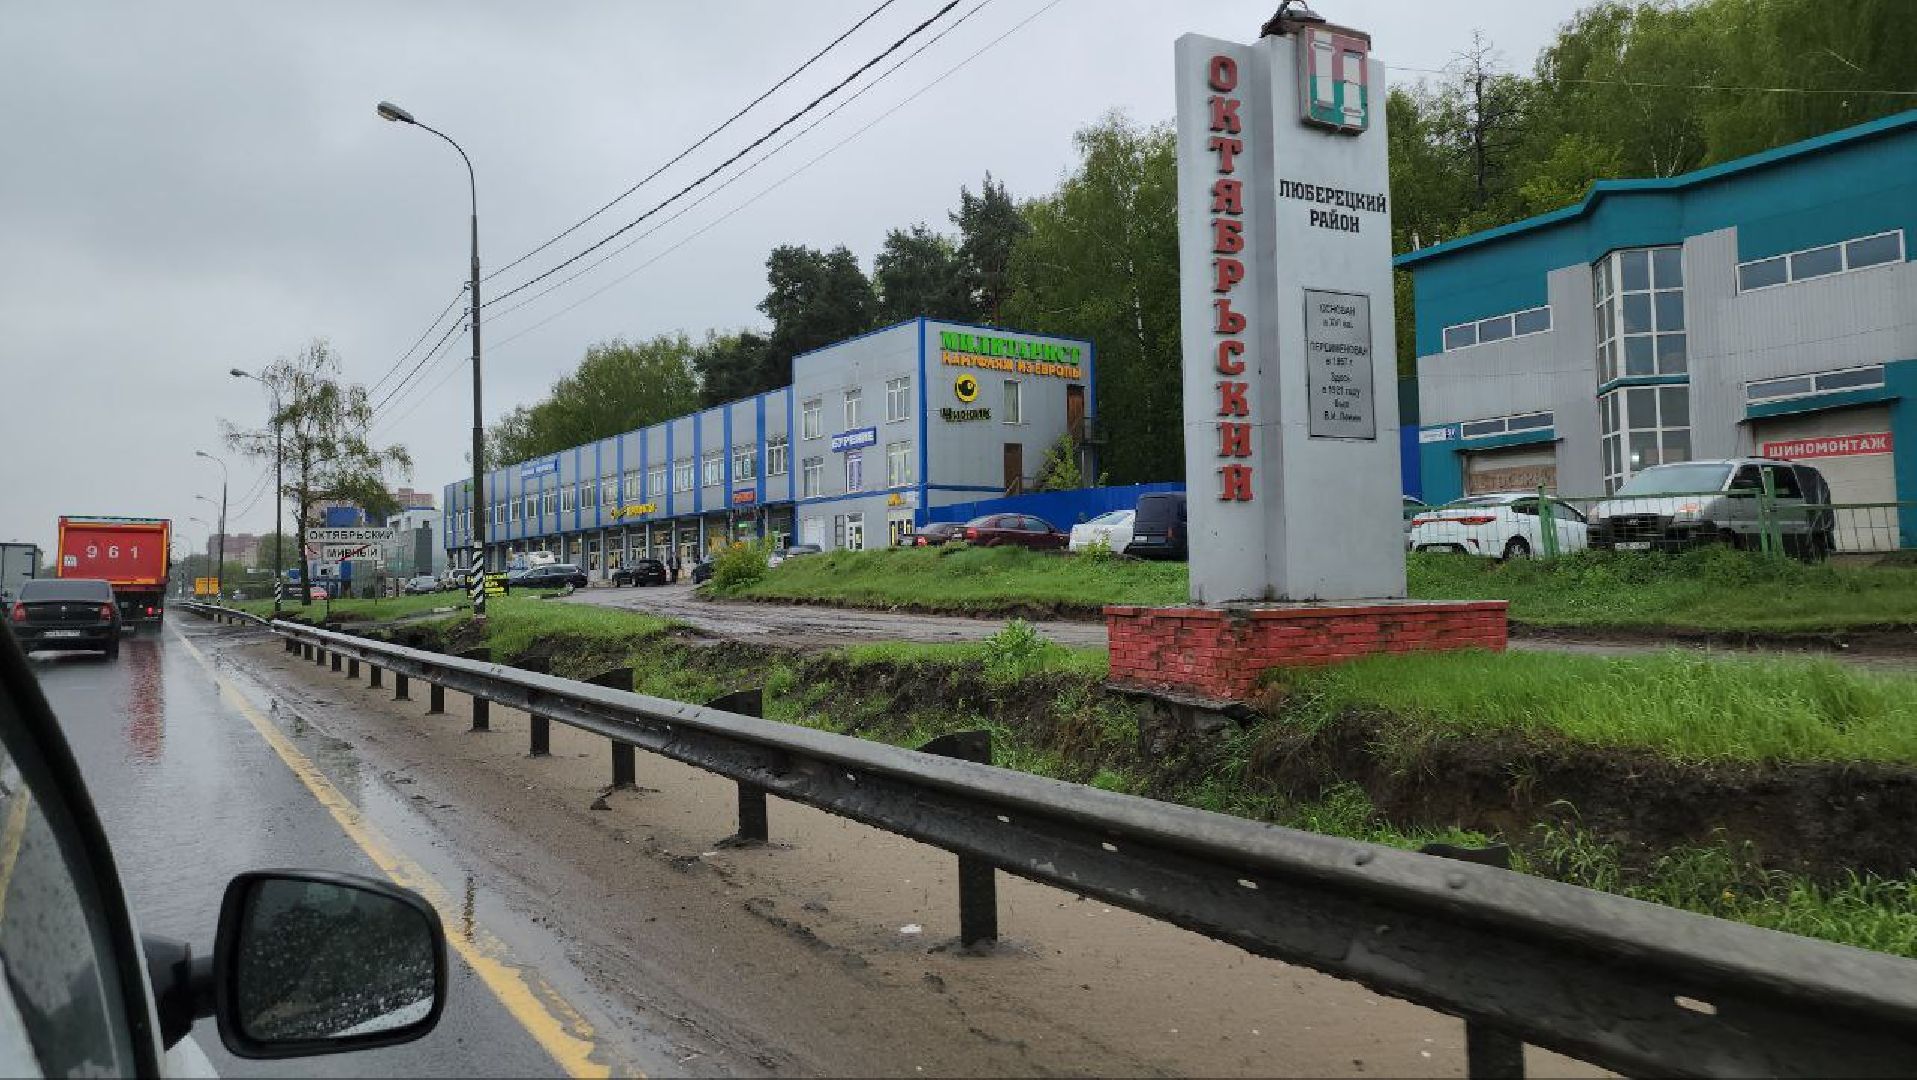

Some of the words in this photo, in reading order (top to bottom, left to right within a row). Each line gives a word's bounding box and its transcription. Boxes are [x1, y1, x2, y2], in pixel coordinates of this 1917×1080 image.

[1280, 179, 1386, 213] ЛЮБЕРЕЦКИЙ
[1310, 209, 1360, 233] РАЙОН
[1208, 55, 1254, 501] ОКТЯБРЬСКИЙ
[1017, 360, 1034, 374] ИЗ
[1769, 437, 1886, 457] ШИНОМОНТАЖ
